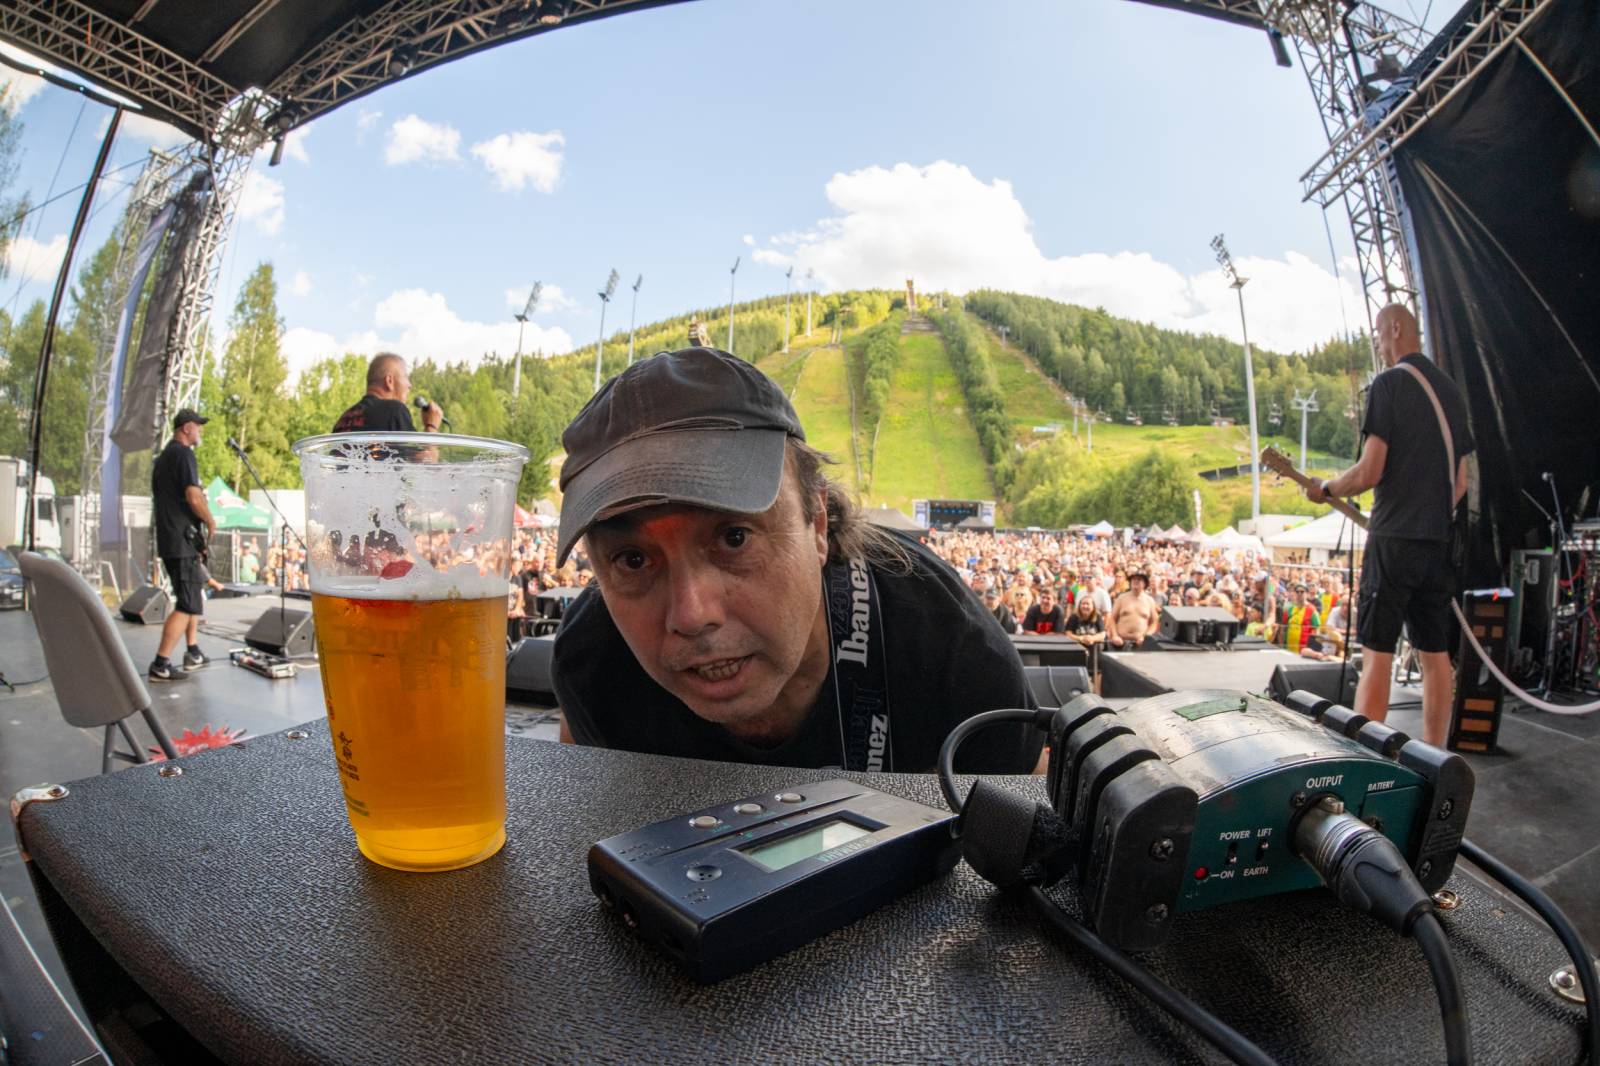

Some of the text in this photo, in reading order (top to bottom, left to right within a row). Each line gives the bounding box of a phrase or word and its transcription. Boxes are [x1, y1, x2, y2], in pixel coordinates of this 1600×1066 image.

[836, 558, 870, 668] Ibanez
[1306, 774, 1344, 789] OUTPUT
[1367, 780, 1395, 792] BATTERY
[1219, 827, 1272, 841] POWER LIFT
[1220, 869, 1235, 879] ON
[1243, 866, 1269, 877] EARTH
